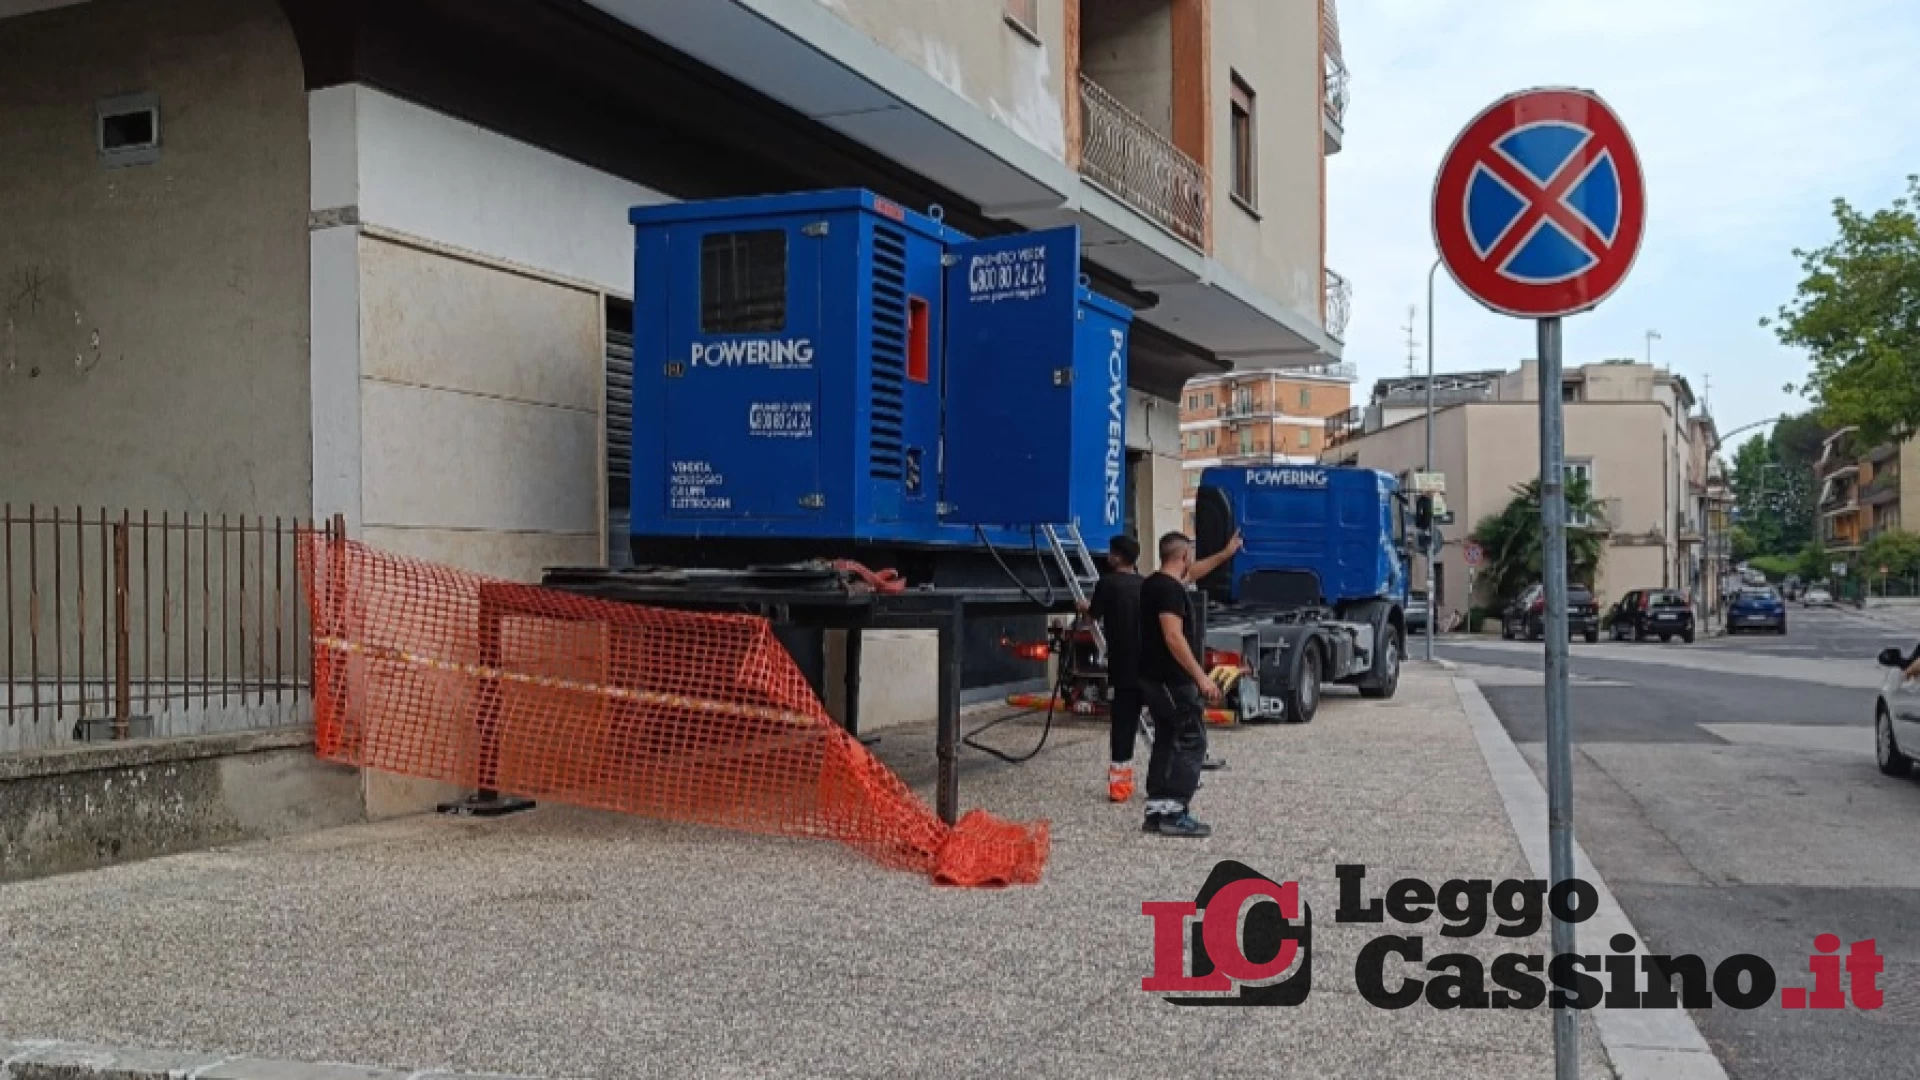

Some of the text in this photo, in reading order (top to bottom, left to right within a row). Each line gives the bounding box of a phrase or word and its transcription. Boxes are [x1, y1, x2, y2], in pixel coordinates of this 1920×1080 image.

[1014, 263, 1029, 287] 24
[1031, 261, 1045, 285] 24
[691, 338, 814, 367] POWERING
[1105, 327, 1124, 526] POWERING
[1246, 468, 1329, 486] POWERING
